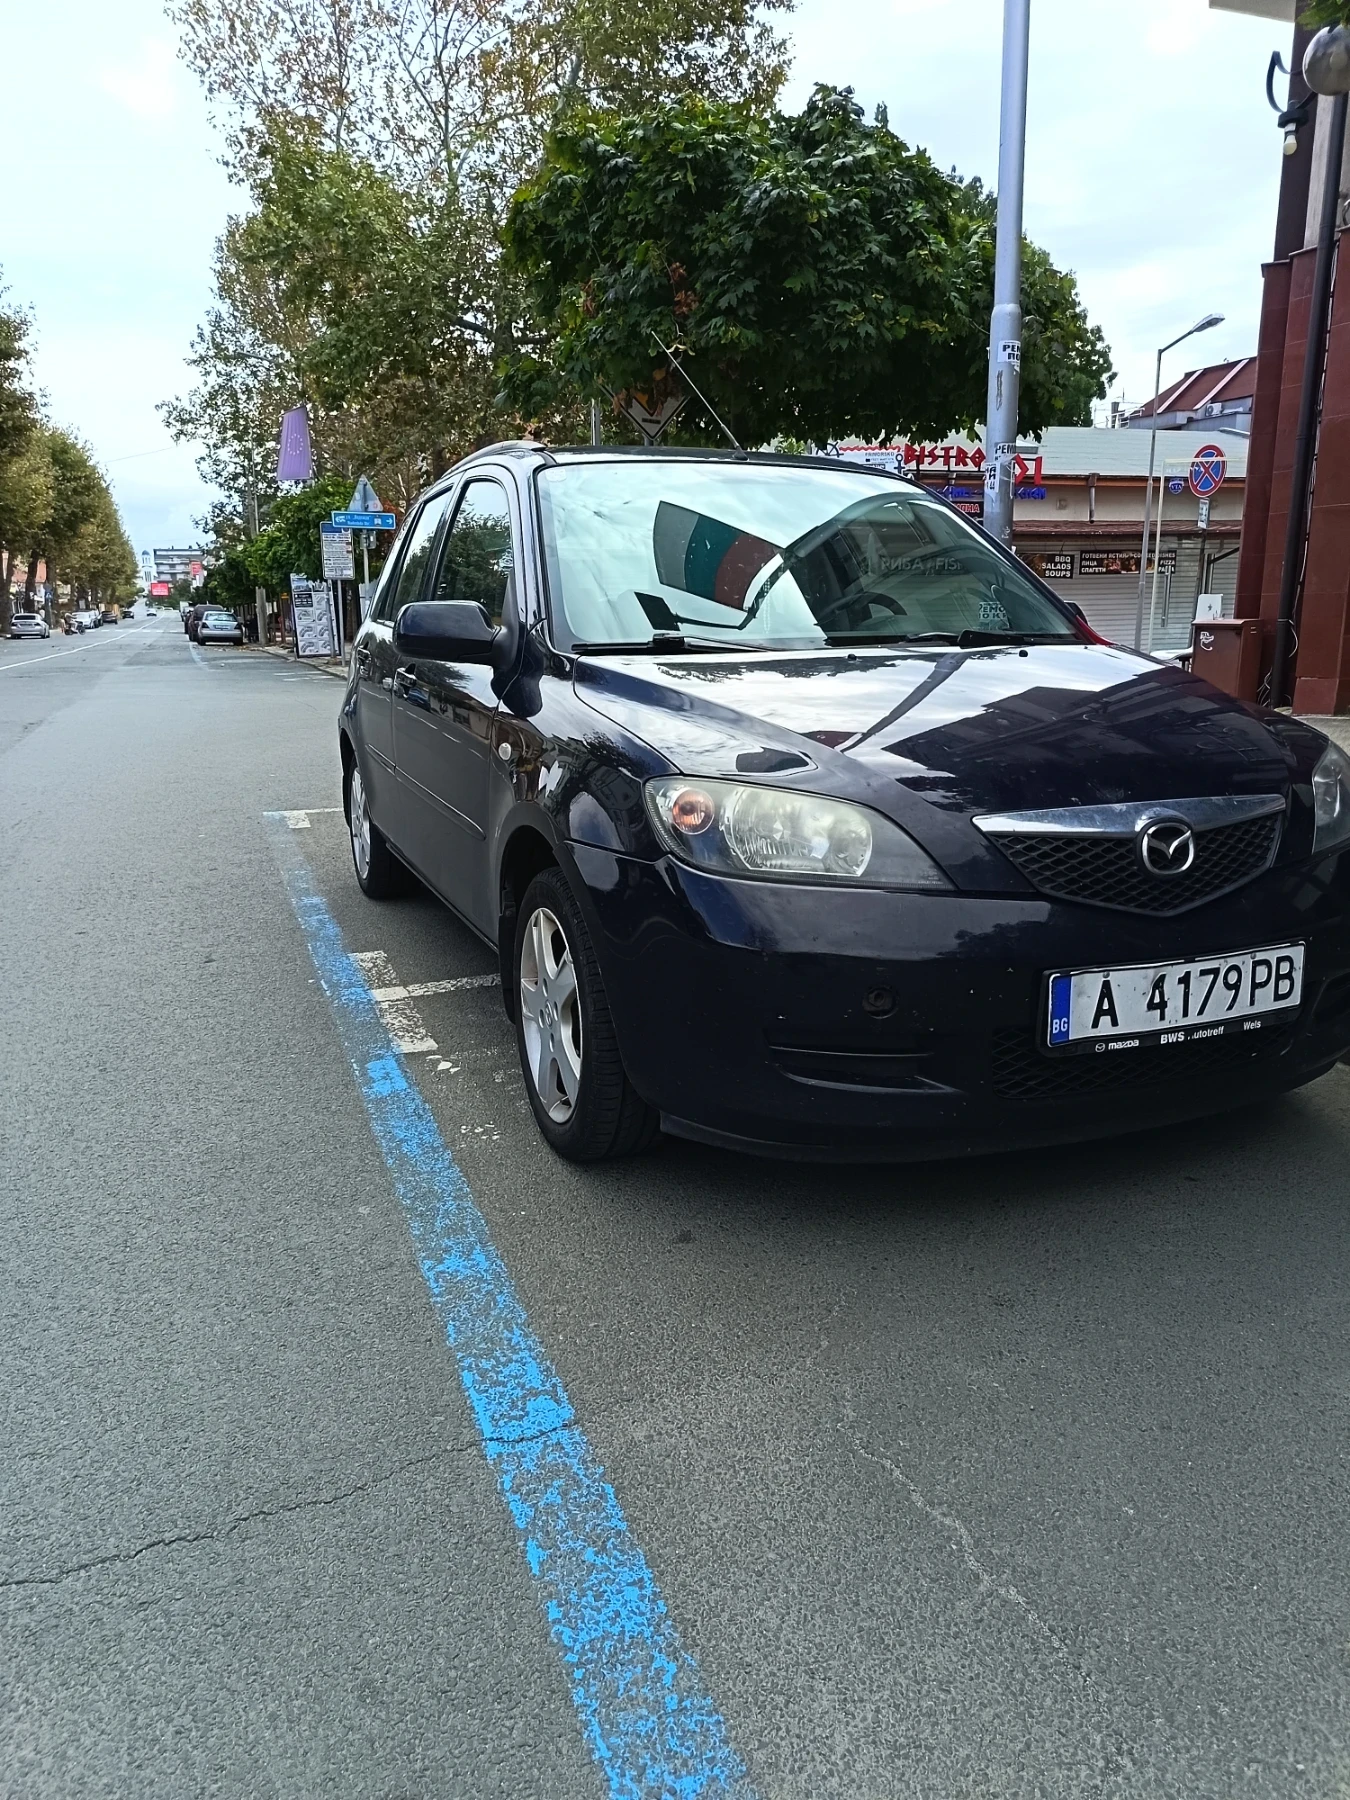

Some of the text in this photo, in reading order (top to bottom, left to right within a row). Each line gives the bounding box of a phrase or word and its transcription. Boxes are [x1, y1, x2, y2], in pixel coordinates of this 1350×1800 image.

[904, 443, 987, 468] BISTRO
[881, 557, 924, 570] РИБА
[1041, 562, 1072, 570] SALADS
[1091, 978, 1120, 1029] A
[1146, 963, 1243, 1022] 4179
[1052, 1017, 1068, 1034] BG
[1160, 1019, 1262, 1045] BWS utotreff Wels
[1107, 1038, 1140, 1050] mazda
